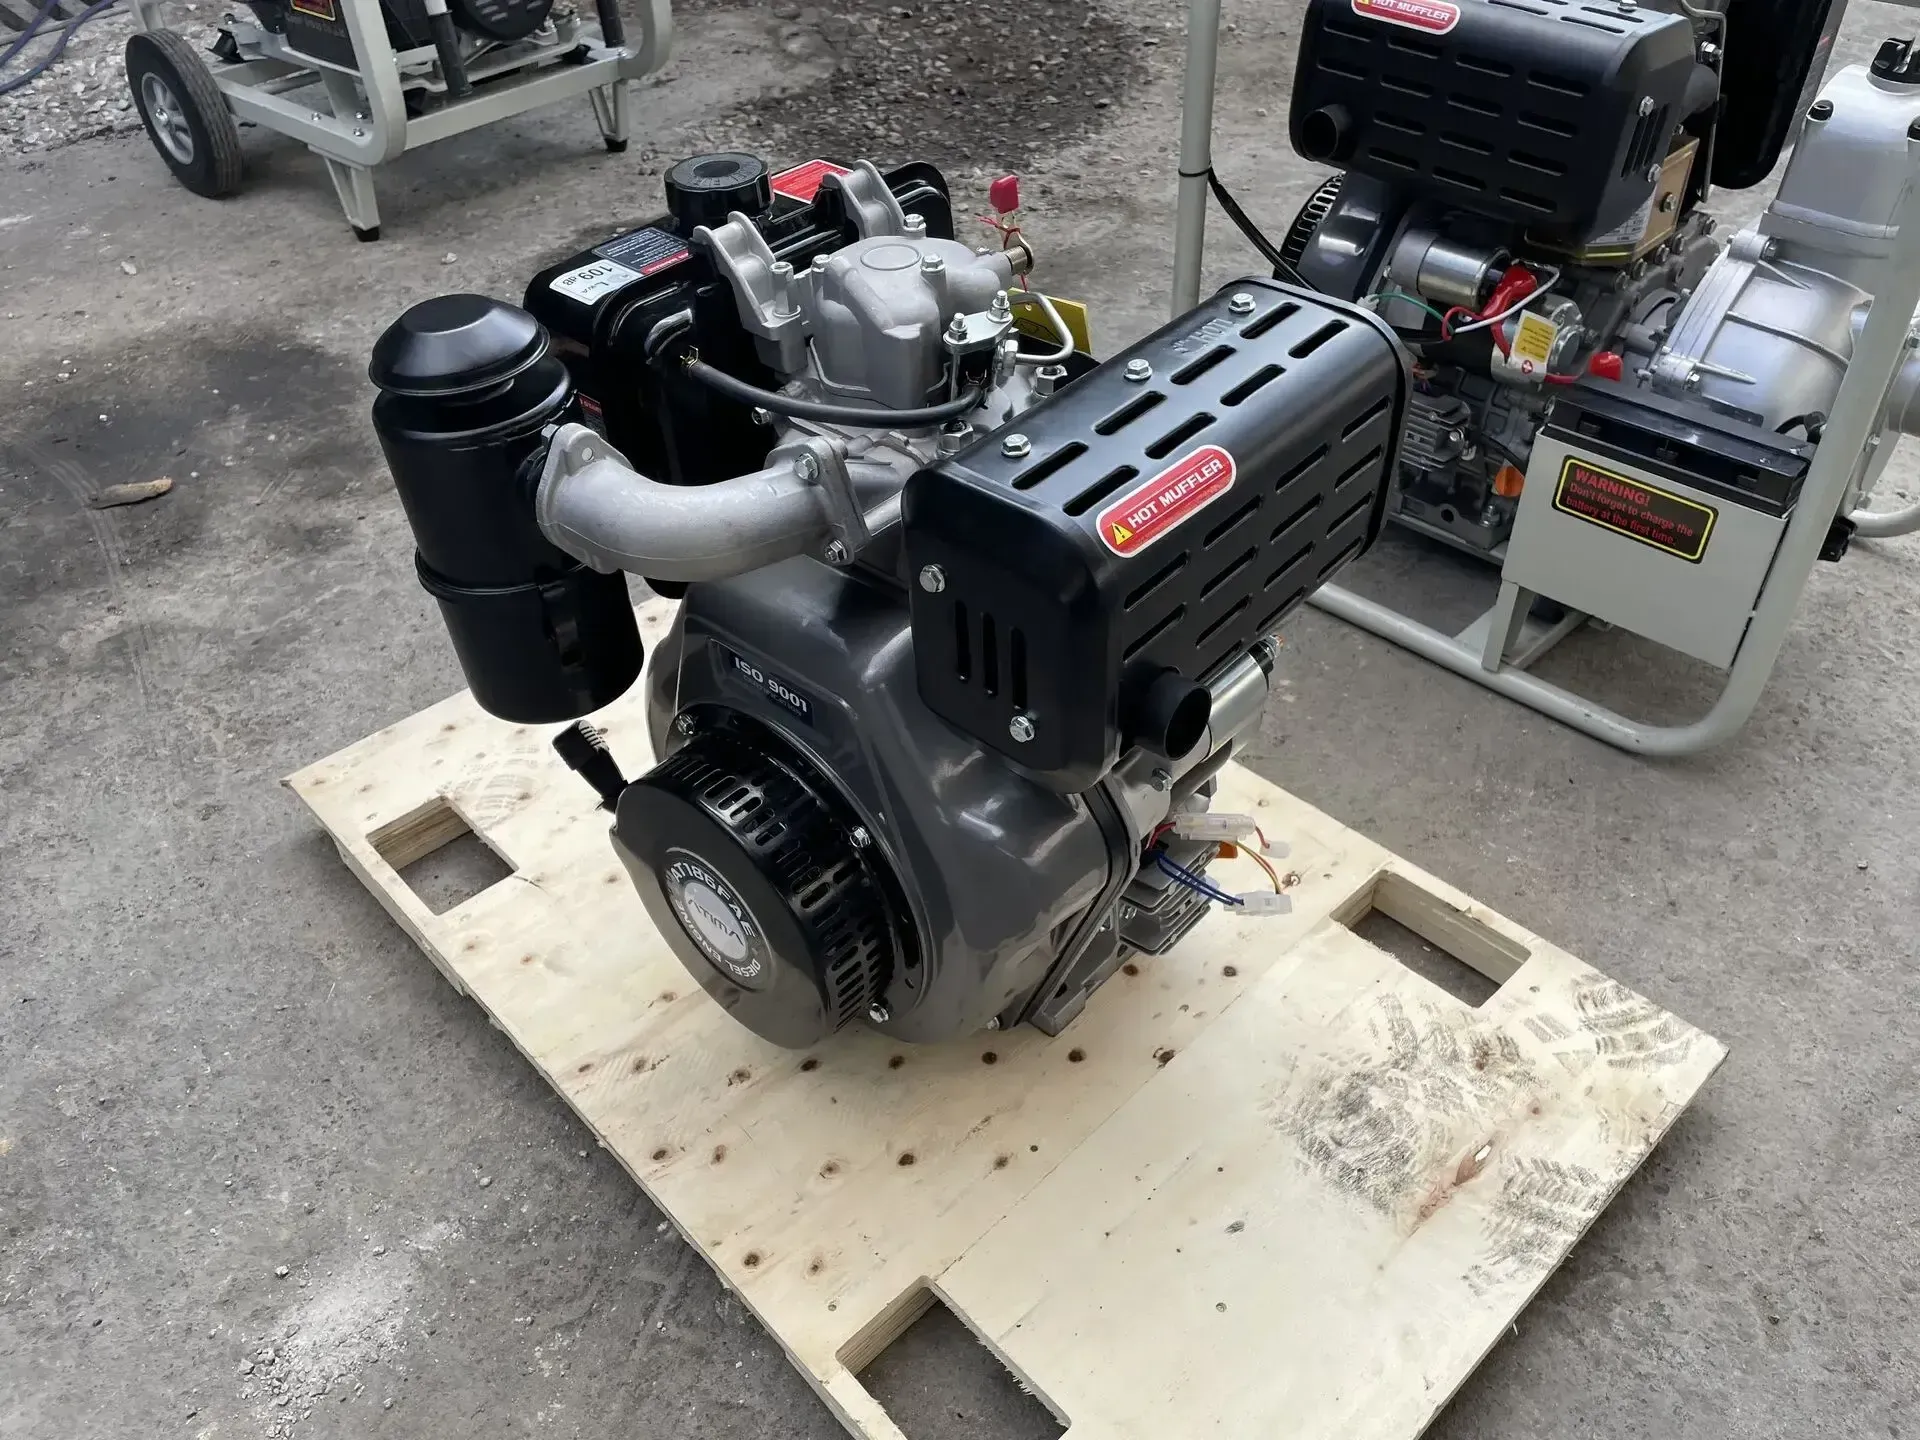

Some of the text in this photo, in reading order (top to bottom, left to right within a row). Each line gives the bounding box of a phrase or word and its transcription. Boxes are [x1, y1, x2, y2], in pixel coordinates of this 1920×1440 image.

[1397, 1, 1450, 20] MUFFLER
[562, 275, 577, 286] dB
[578, 265, 613, 280] 109
[1127, 502, 1158, 528] HOT
[1159, 459, 1223, 507] MUFFLER
[1576, 468, 1650, 506] WARNING!
[1566, 495, 1599, 517] battery
[1600, 509, 1611, 521] at
[1612, 513, 1628, 527] the
[1630, 518, 1650, 536] first
[1570, 483, 1694, 537] Don't forget to charge the
[735, 657, 763, 683] ISO
[768, 679, 807, 712] 9001
[675, 899, 722, 962] ENGINE
